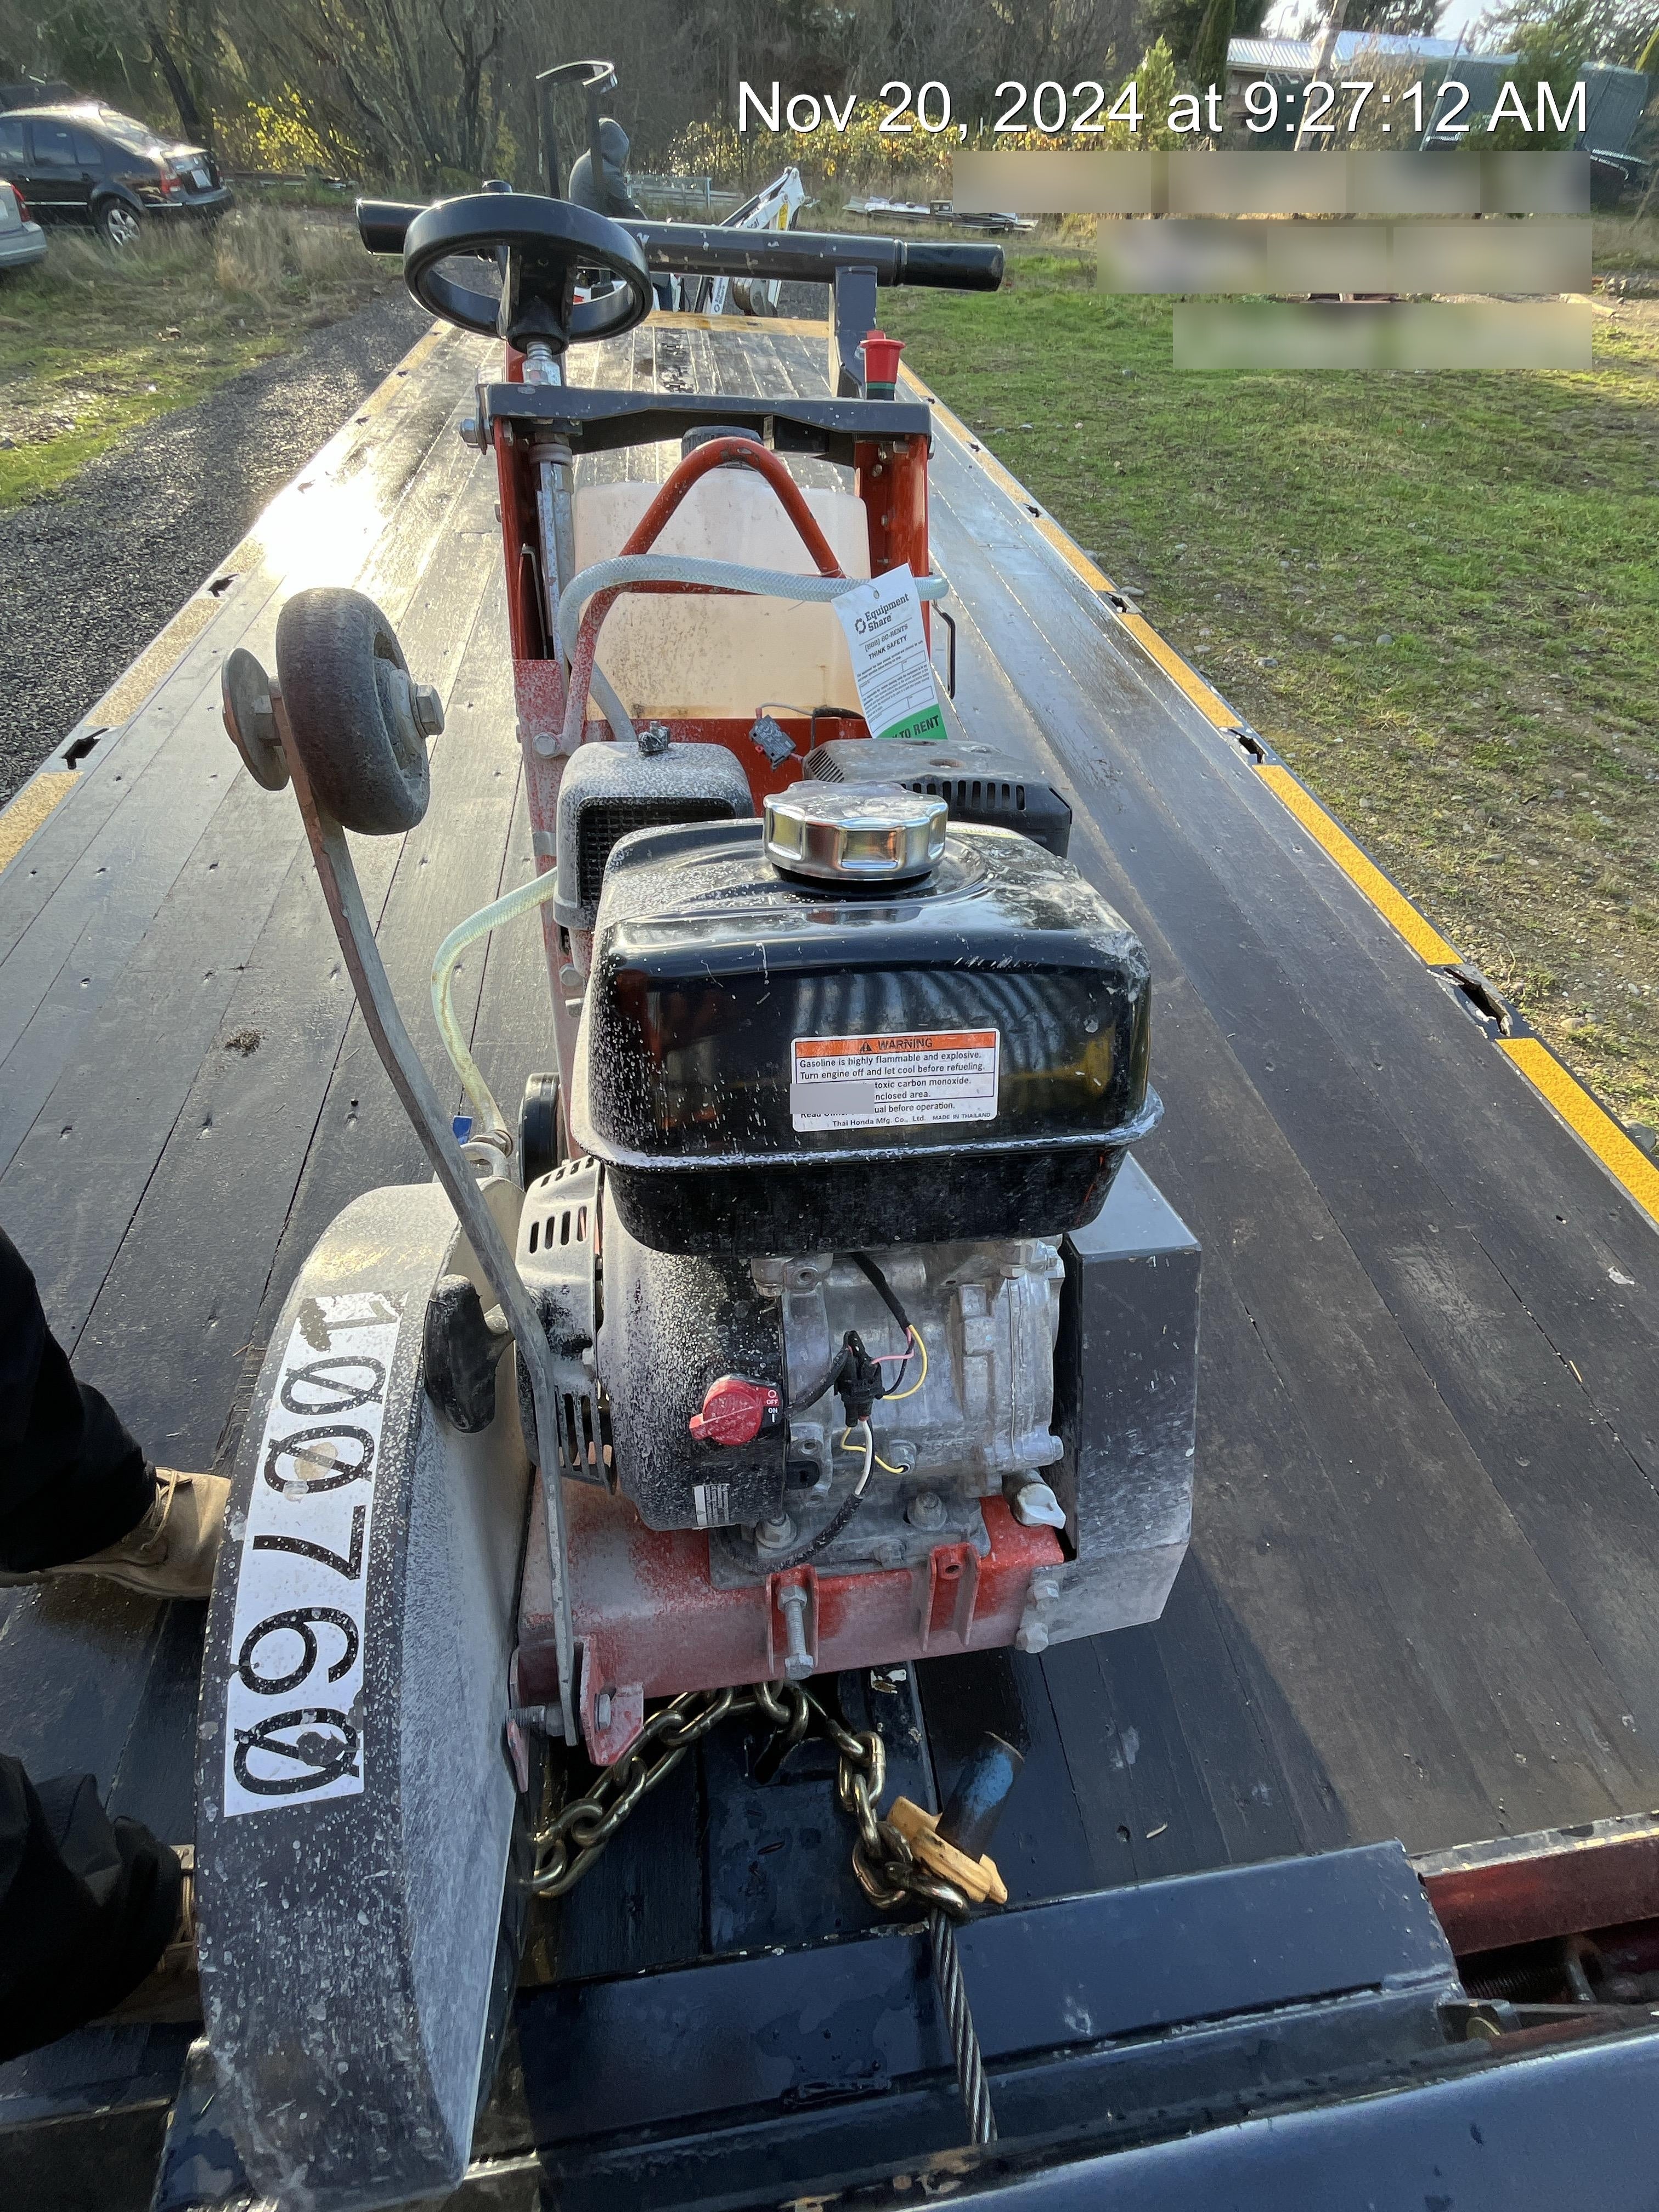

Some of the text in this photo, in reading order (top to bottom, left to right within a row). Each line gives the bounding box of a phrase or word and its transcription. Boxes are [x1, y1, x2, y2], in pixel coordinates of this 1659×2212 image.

[865, 593, 910, 621] Equipment
[868, 614, 892, 632] Share
[868, 635, 907, 659] THINK SAFETY
[899, 715, 939, 738] TO RENT
[878, 1037, 933, 1050] WARNING
[800, 1059, 836, 1068] Gasoline
[848, 1057, 873, 1066] highly
[876, 1054, 920, 1063] flammable
[923, 1052, 938, 1061] and
[941, 1051, 981, 1061] explosive.
[800, 1071, 819, 1080] Turn
[821, 1070, 850, 1080] engine
[866, 1067, 882, 1076] and
[884, 1066, 895, 1075] let
[898, 1065, 915, 1074] cool
[918, 1064, 944, 1073] before
[947, 1062, 985, 1071] refueling.
[874, 1076, 972, 1089] toxic carbon monoxide.
[874, 1091, 907, 1101] nclosed
[889, 1104, 913, 1113] before
[916, 1101, 955, 1113] operation.
